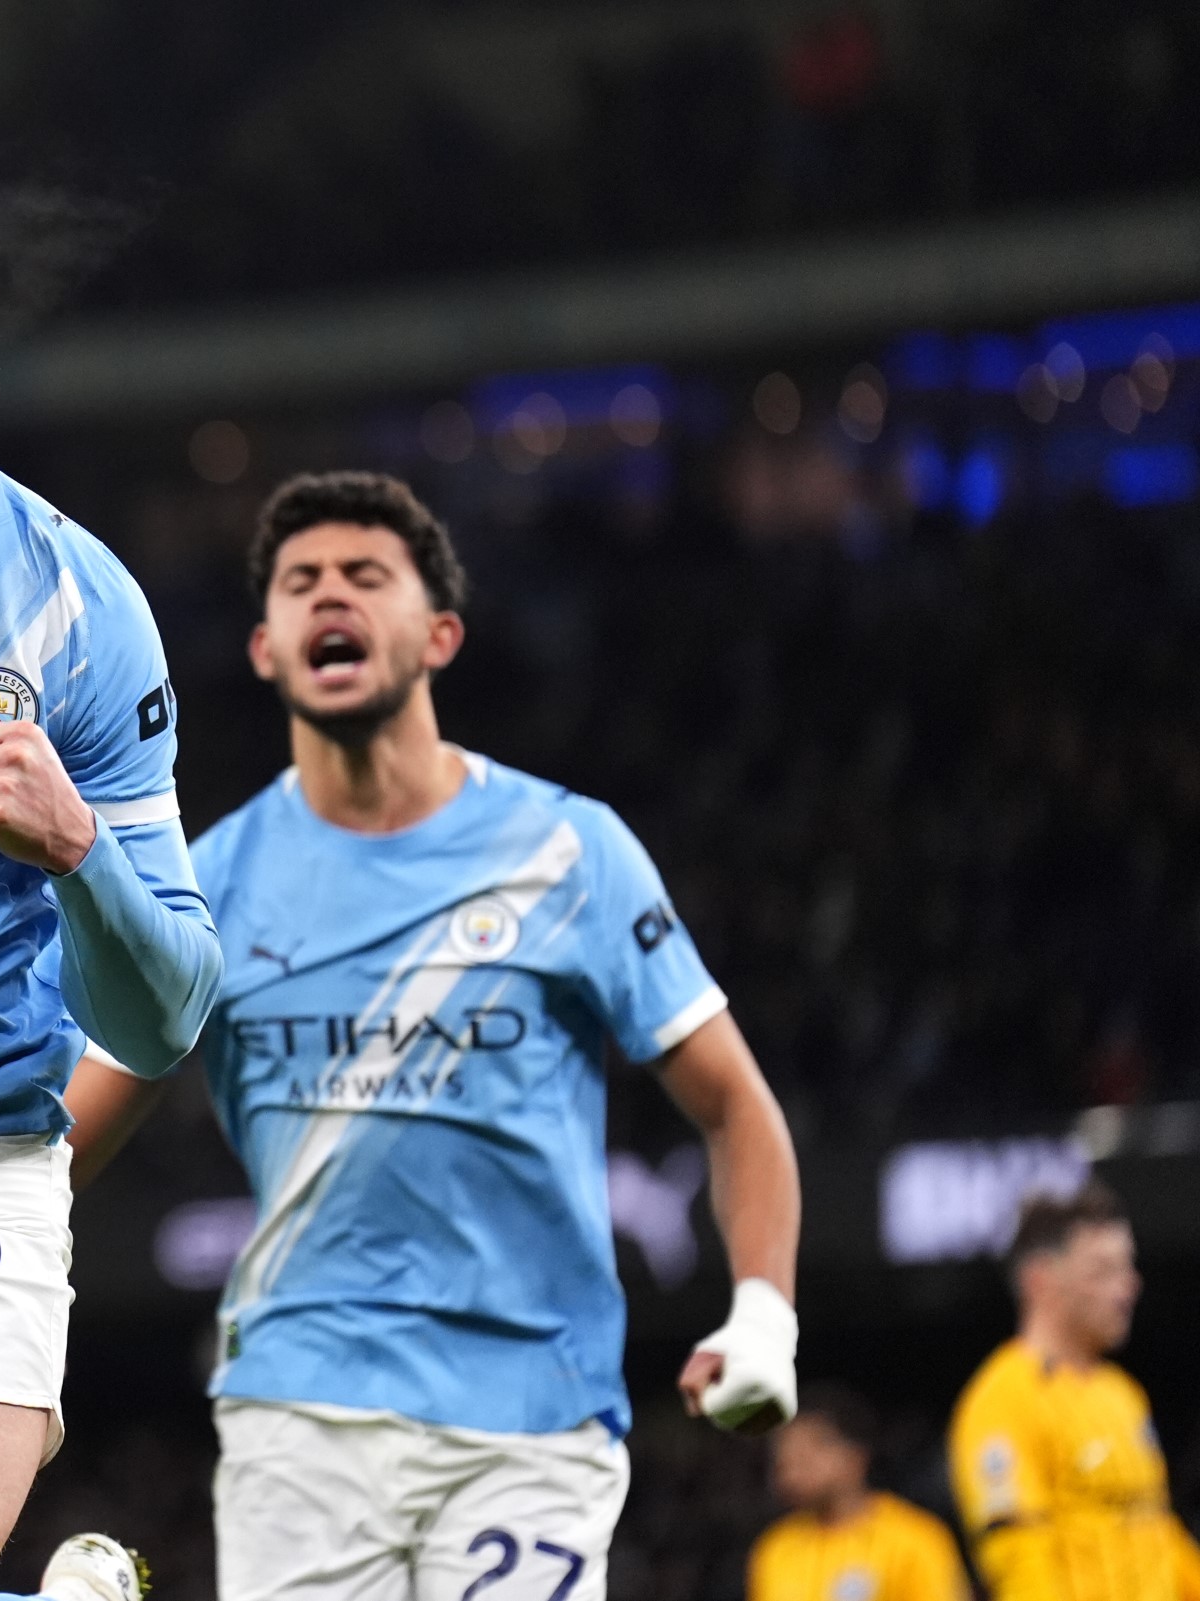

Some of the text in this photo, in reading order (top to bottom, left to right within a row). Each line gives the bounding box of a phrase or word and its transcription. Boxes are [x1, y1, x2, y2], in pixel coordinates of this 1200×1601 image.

[232, 1006, 526, 1057] ETIHAD
[286, 1068, 465, 1101] AIRWAYS
[461, 1527, 586, 1601] 27
